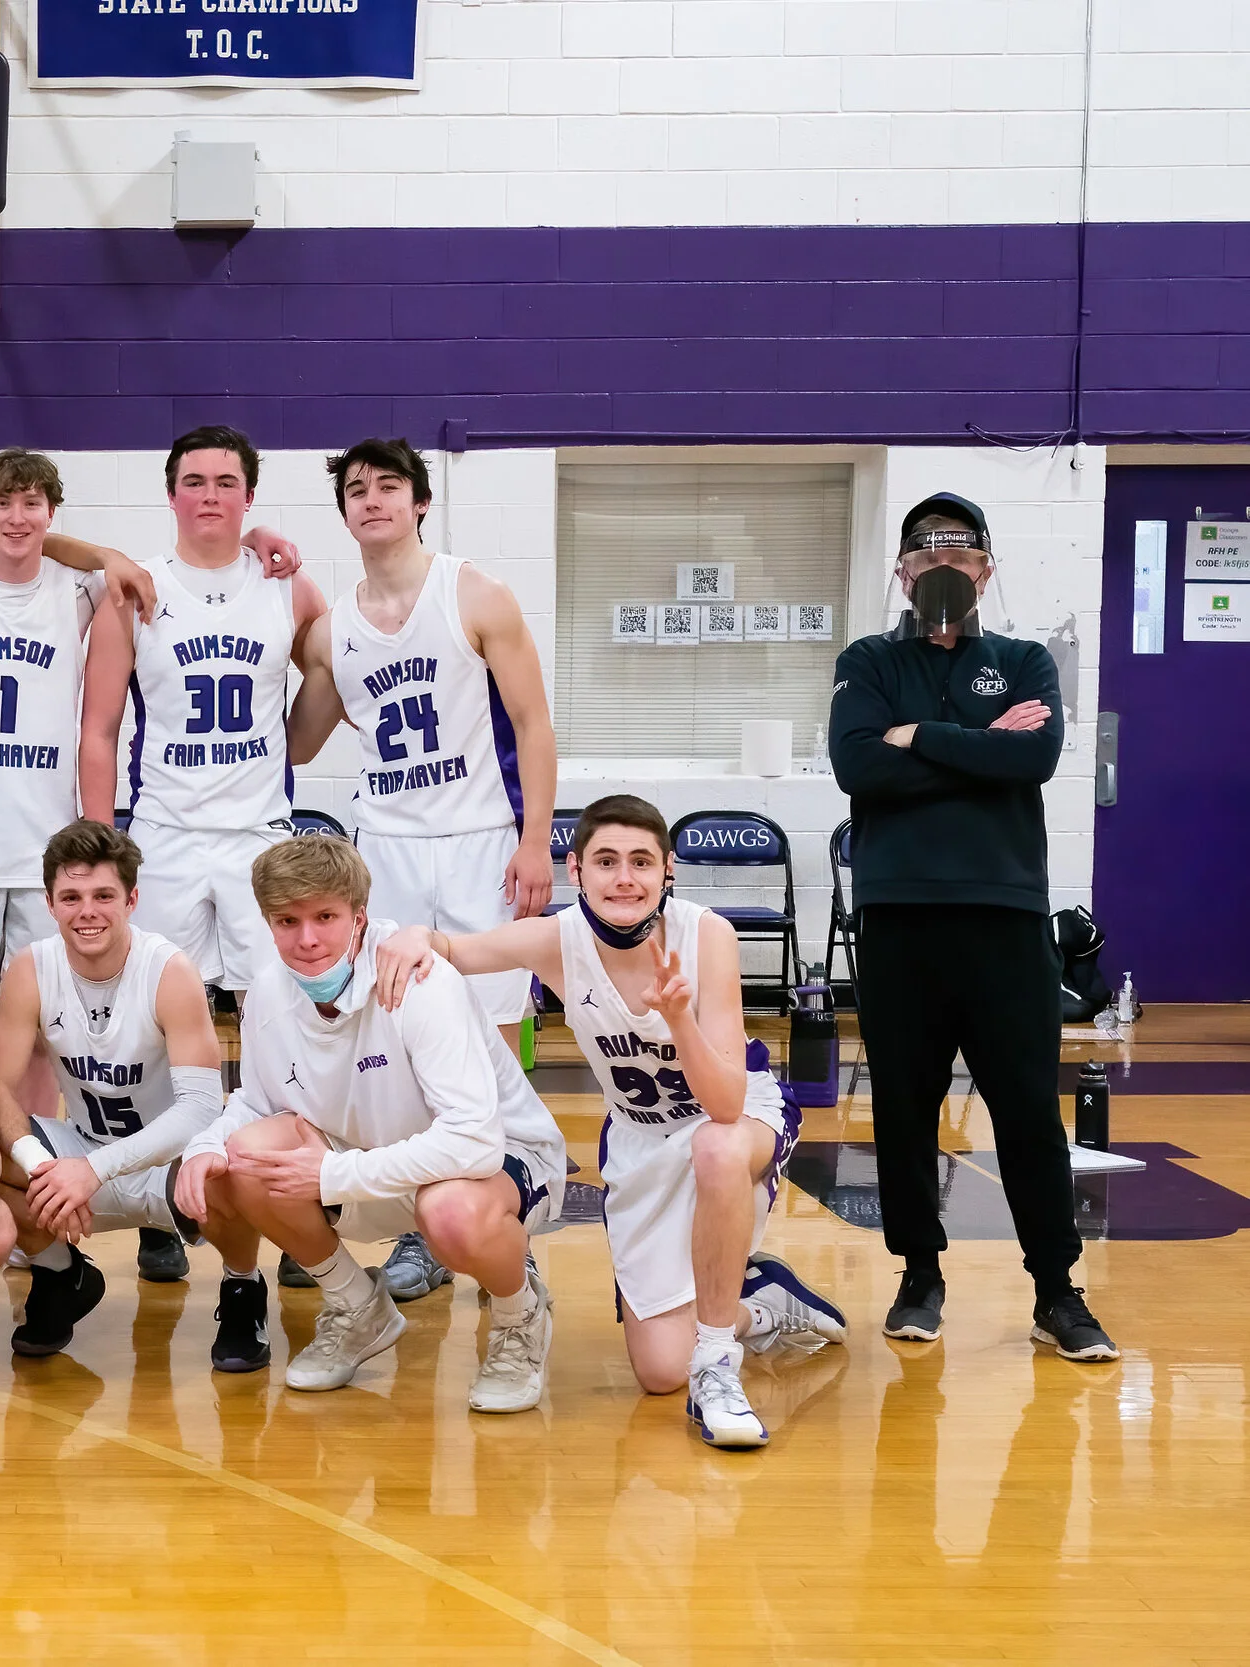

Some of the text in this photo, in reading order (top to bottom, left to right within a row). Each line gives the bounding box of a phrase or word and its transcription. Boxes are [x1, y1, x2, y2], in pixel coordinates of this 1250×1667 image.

[926, 533, 967, 542] Fce Shield
[1207, 547, 1239, 555] RFH PE
[1195, 559, 1222, 568] CODE:
[173, 634, 265, 668] RUMSON
[363, 657, 438, 700] RUMSON
[976, 680, 1004, 690] RFH
[0, 675, 19, 734] 1
[184, 674, 254, 734] 30
[375, 692, 440, 763] 24
[163, 736, 269, 767] FAIR HAVEN
[367, 754, 469, 796] FAIR HAVEN
[684, 828, 770, 848] DAWGS
[594, 1031, 679, 1062] RUMSO
[357, 1054, 388, 1073] DAWGS
[80, 1087, 144, 1138] 15
